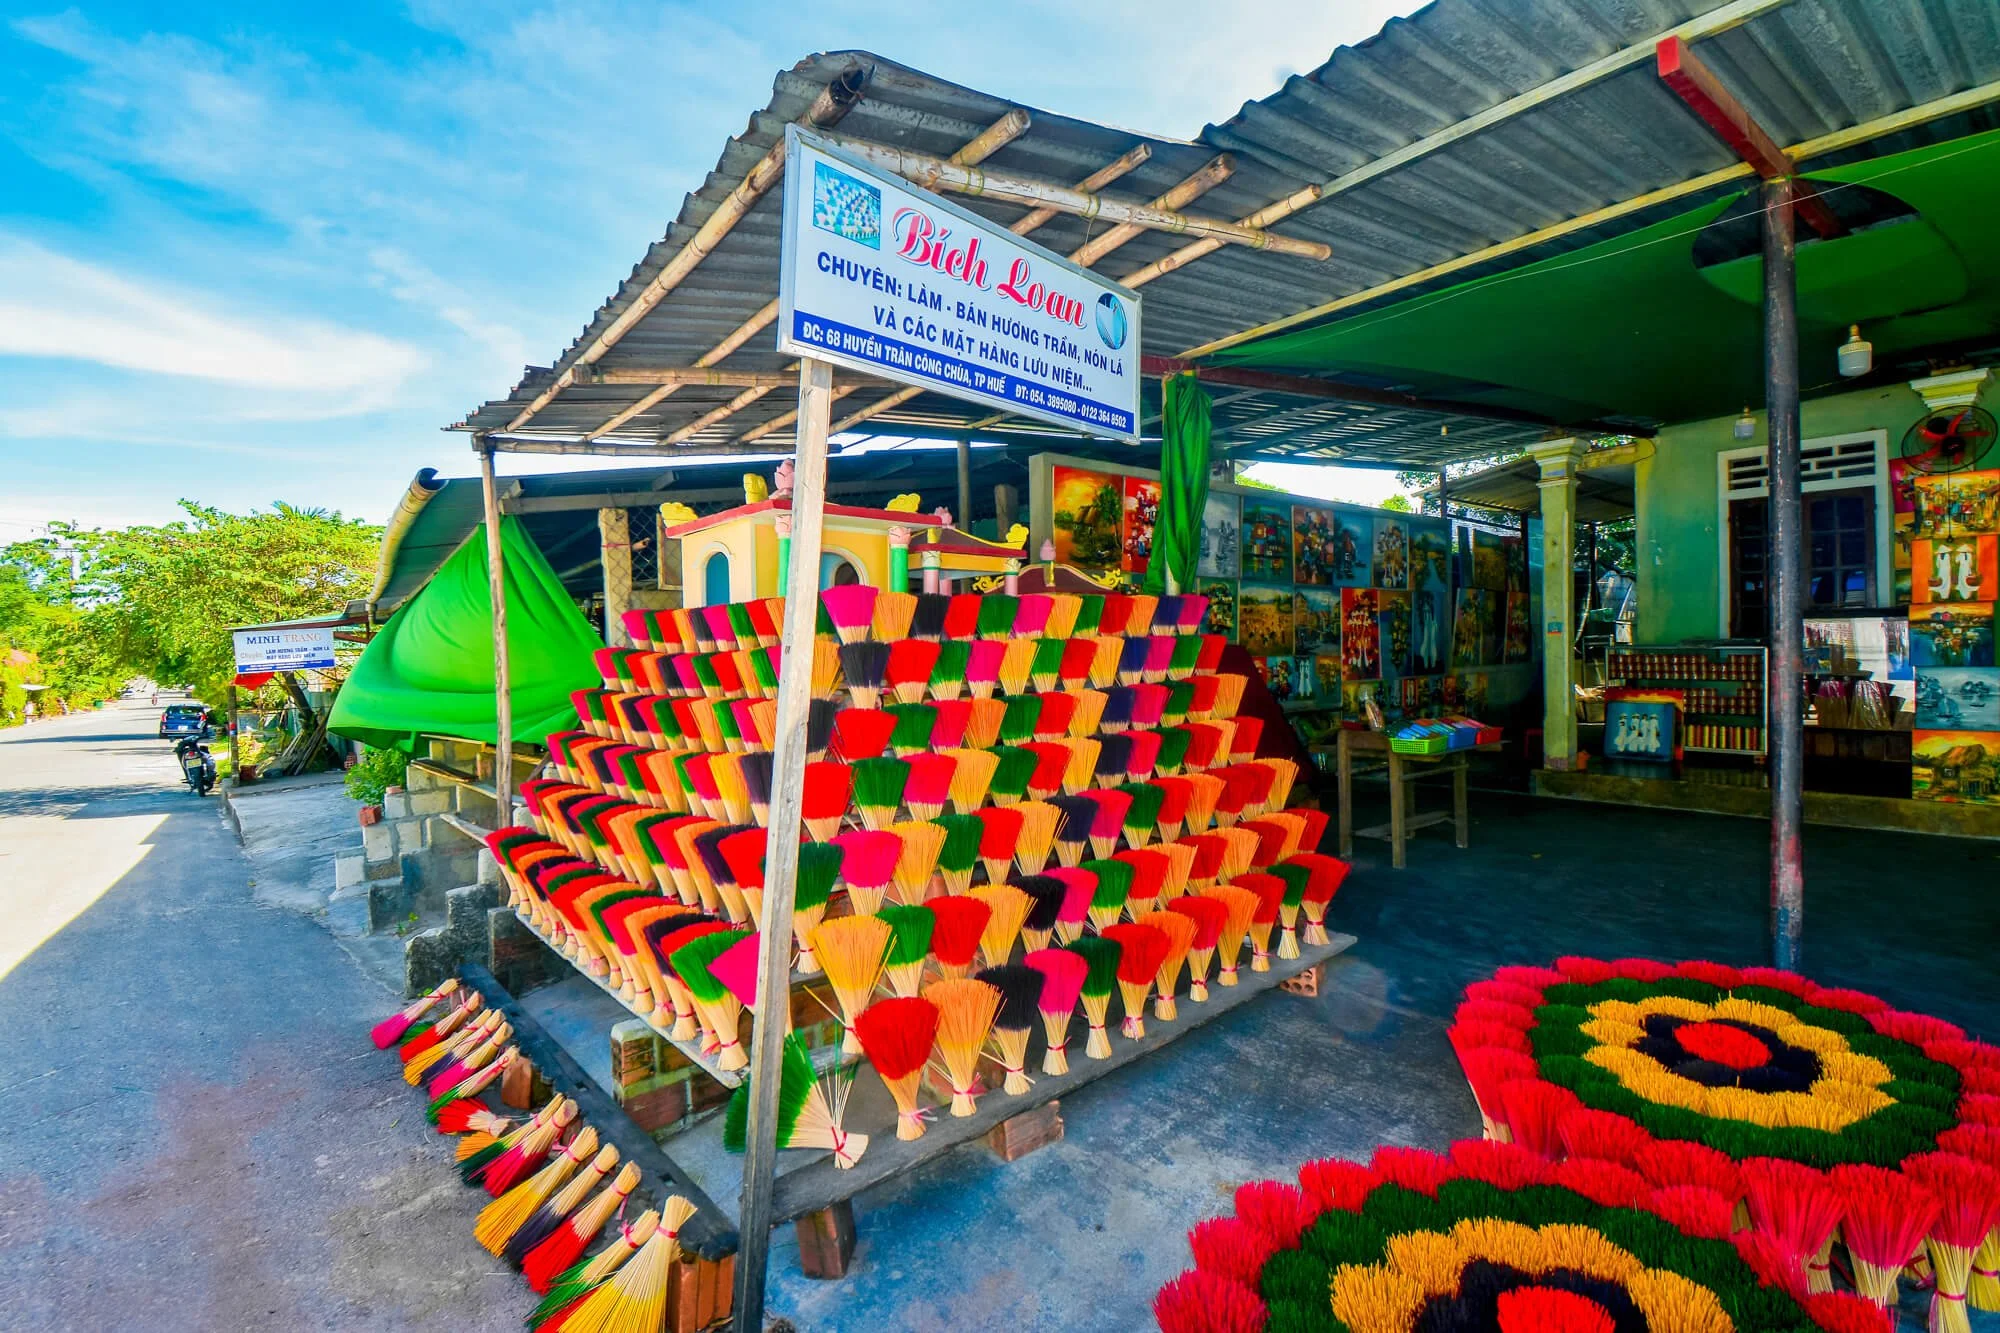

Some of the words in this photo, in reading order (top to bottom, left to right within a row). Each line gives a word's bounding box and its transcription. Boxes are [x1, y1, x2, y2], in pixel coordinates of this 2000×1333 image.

[817, 251, 902, 297] CHUYÊN:
[908, 283, 942, 311] LÀM
[956, 301, 987, 328] BÁN
[992, 314, 1039, 347] HƯƠNG
[1084, 348, 1107, 370] NÓN
[1110, 358, 1123, 377] LÁ
[892, 207, 990, 290] Bích
[997, 258, 1086, 329] Loan
[803, 321, 824, 343] ĐC:
[826, 329, 841, 347] 68
[843, 333, 882, 359] HUYỀN
[914, 353, 942, 376] CÔNG
[944, 363, 972, 387] CHÚA,
[974, 371, 986, 388] TP
[987, 375, 1007, 394] HUẾ
[1015, 384, 1029, 400] ĐT:
[1081, 404, 1098, 420] 0122
[873, 305, 897, 331] VÀ
[902, 316, 937, 343] CÁC
[942, 328, 975, 356] MẶT
[979, 341, 1019, 369] HÀNG
[1023, 356, 1049, 378] LƯU
[246, 635, 280, 645] MINH
[284, 632, 321, 643] TRANG
